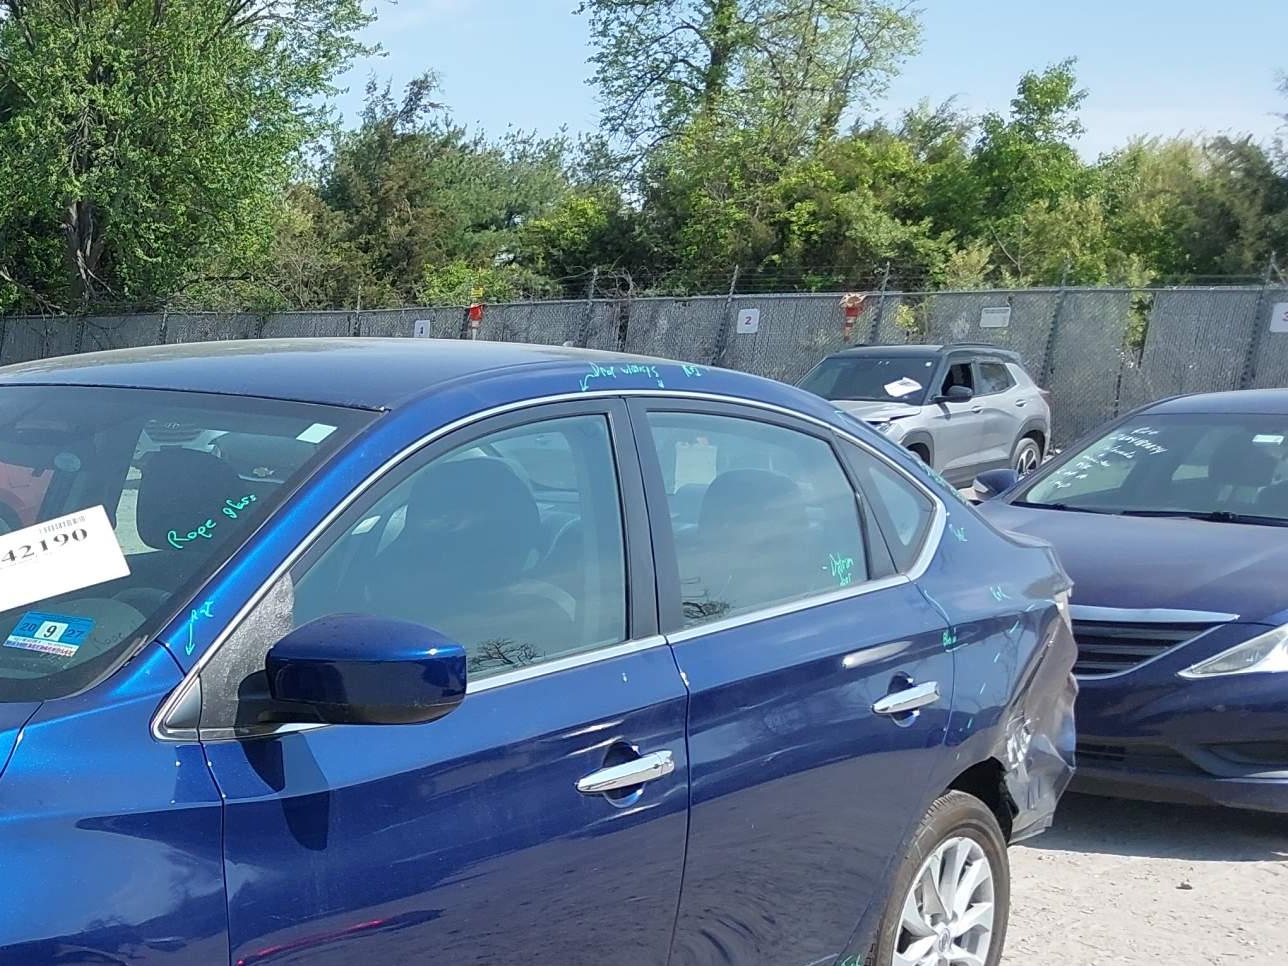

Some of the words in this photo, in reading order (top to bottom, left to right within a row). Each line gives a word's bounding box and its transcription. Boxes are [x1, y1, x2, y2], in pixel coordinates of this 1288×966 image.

[745, 316, 752, 325] 2
[167, 519, 216, 549] Rope
[20, 623, 37, 632] 20
[43, 625, 58, 638] 9
[65, 629, 85, 638] 27
